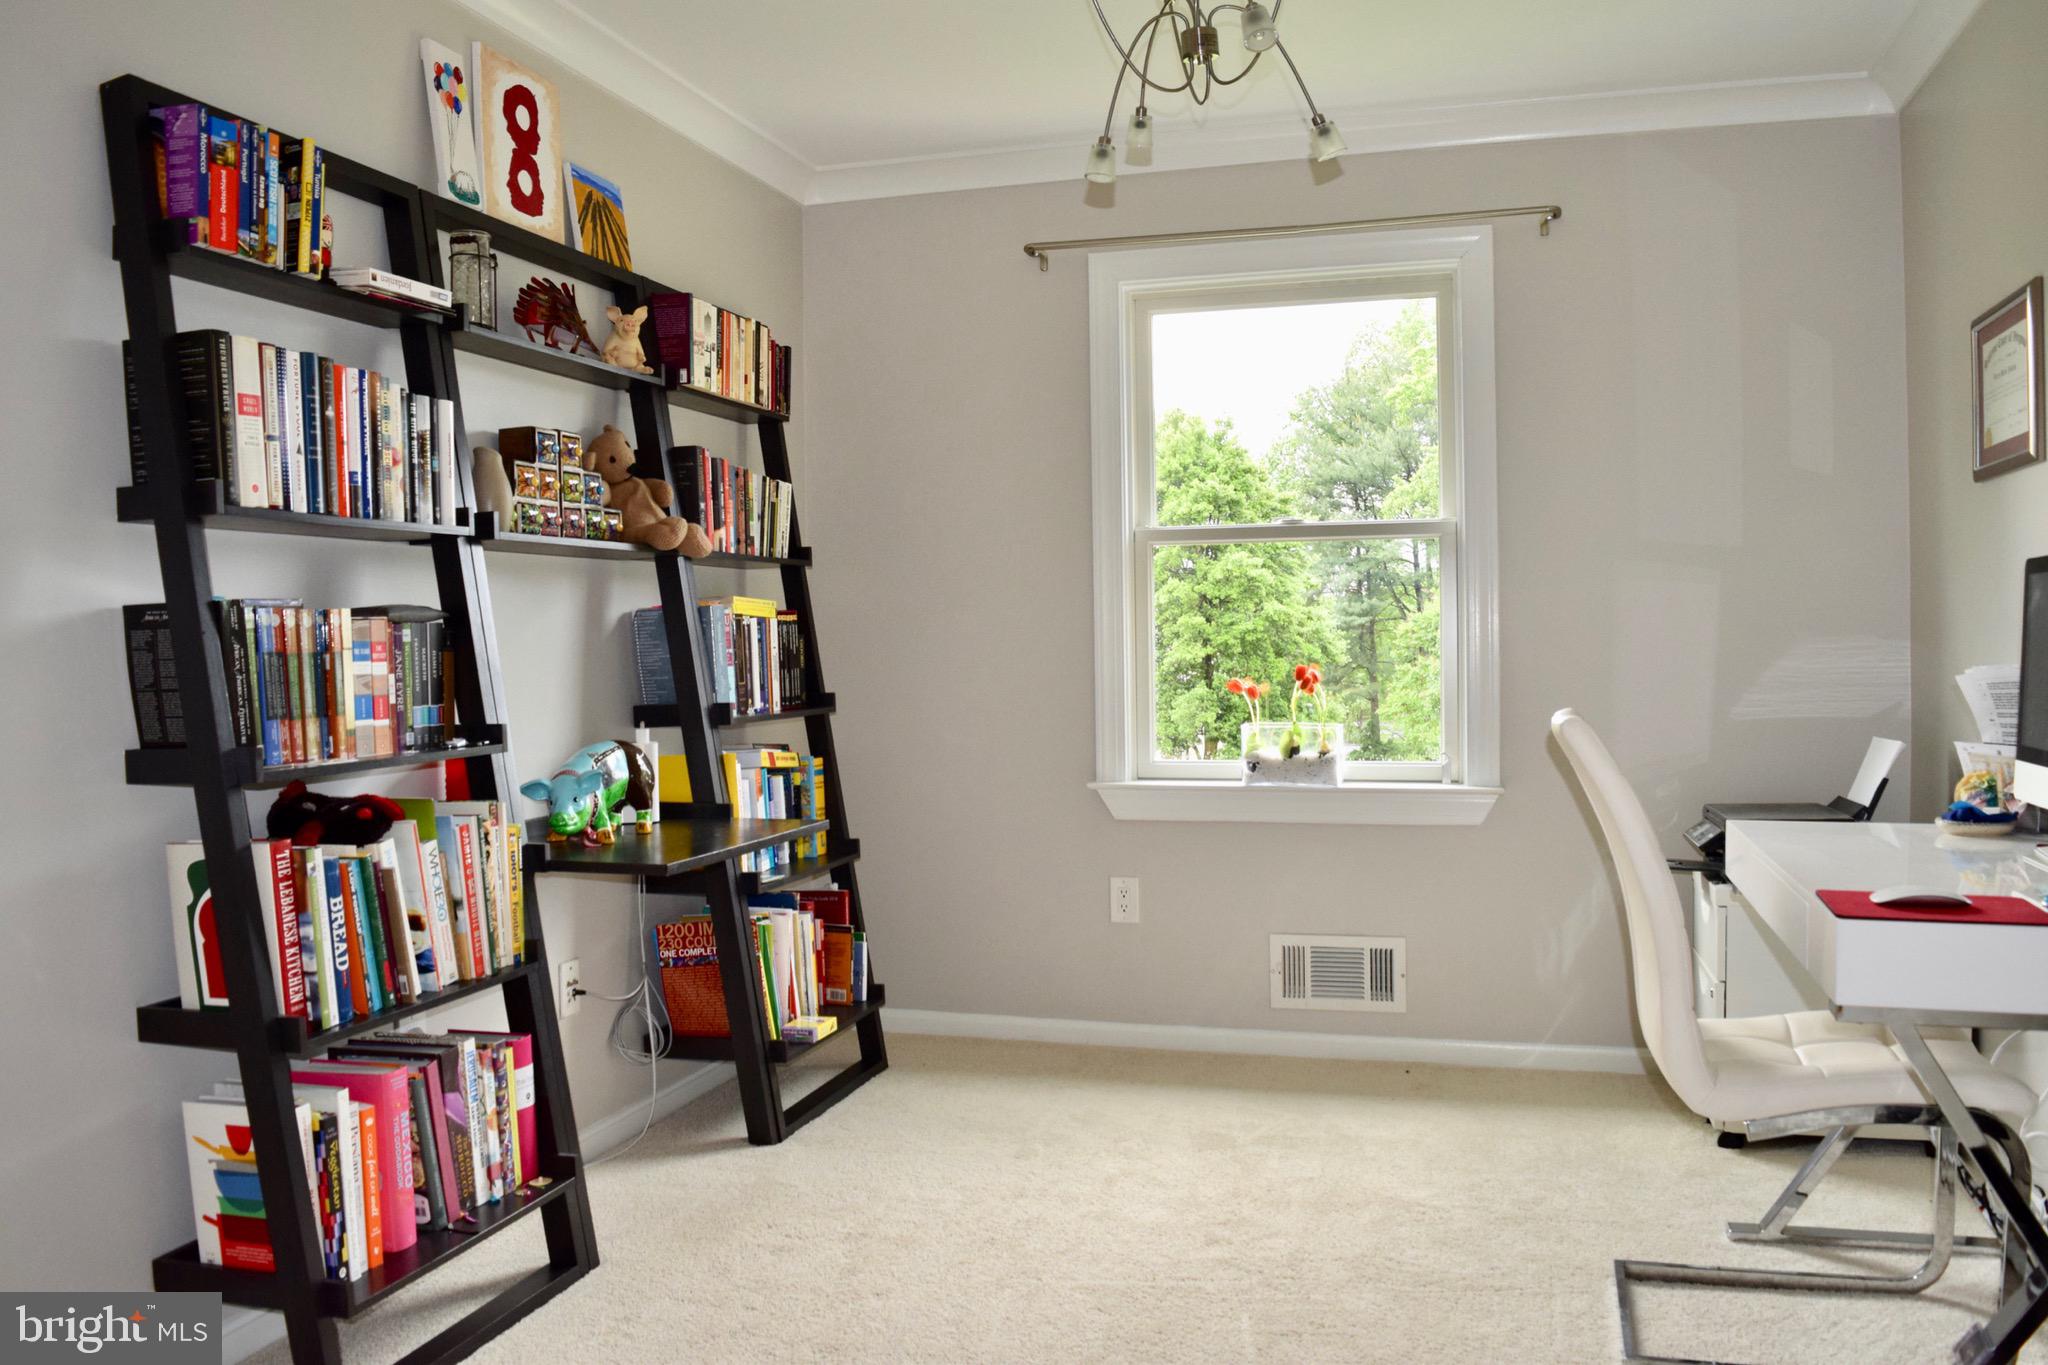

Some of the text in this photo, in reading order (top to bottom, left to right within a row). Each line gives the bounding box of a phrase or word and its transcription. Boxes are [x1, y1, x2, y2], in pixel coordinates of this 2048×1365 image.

[199, 132, 207, 174] Morocco
[269, 159, 278, 203] SCOTTISH
[218, 338, 230, 413] THUNDERSTRUCK
[395, 649, 404, 712] JANE EYRE
[428, 848, 448, 922] WHOLE30
[508, 850, 522, 945] IDIOT'S Football
[275, 849, 302, 1004] THE LEBANESE KITCHEN
[329, 895, 349, 972] BREAD
[657, 923, 694, 938] 1200
[659, 936, 716, 950] 230 COU
[660, 949, 677, 958] ONE
[466, 1050, 479, 1104] JERUSALEM
[350, 1125, 361, 1183] Persiana
[392, 1115, 400, 1140] THE
[399, 1110, 413, 1189] MEXICO
[328, 1140, 341, 1209] Veggiestan
[455, 1135, 469, 1197] MOROCCO
